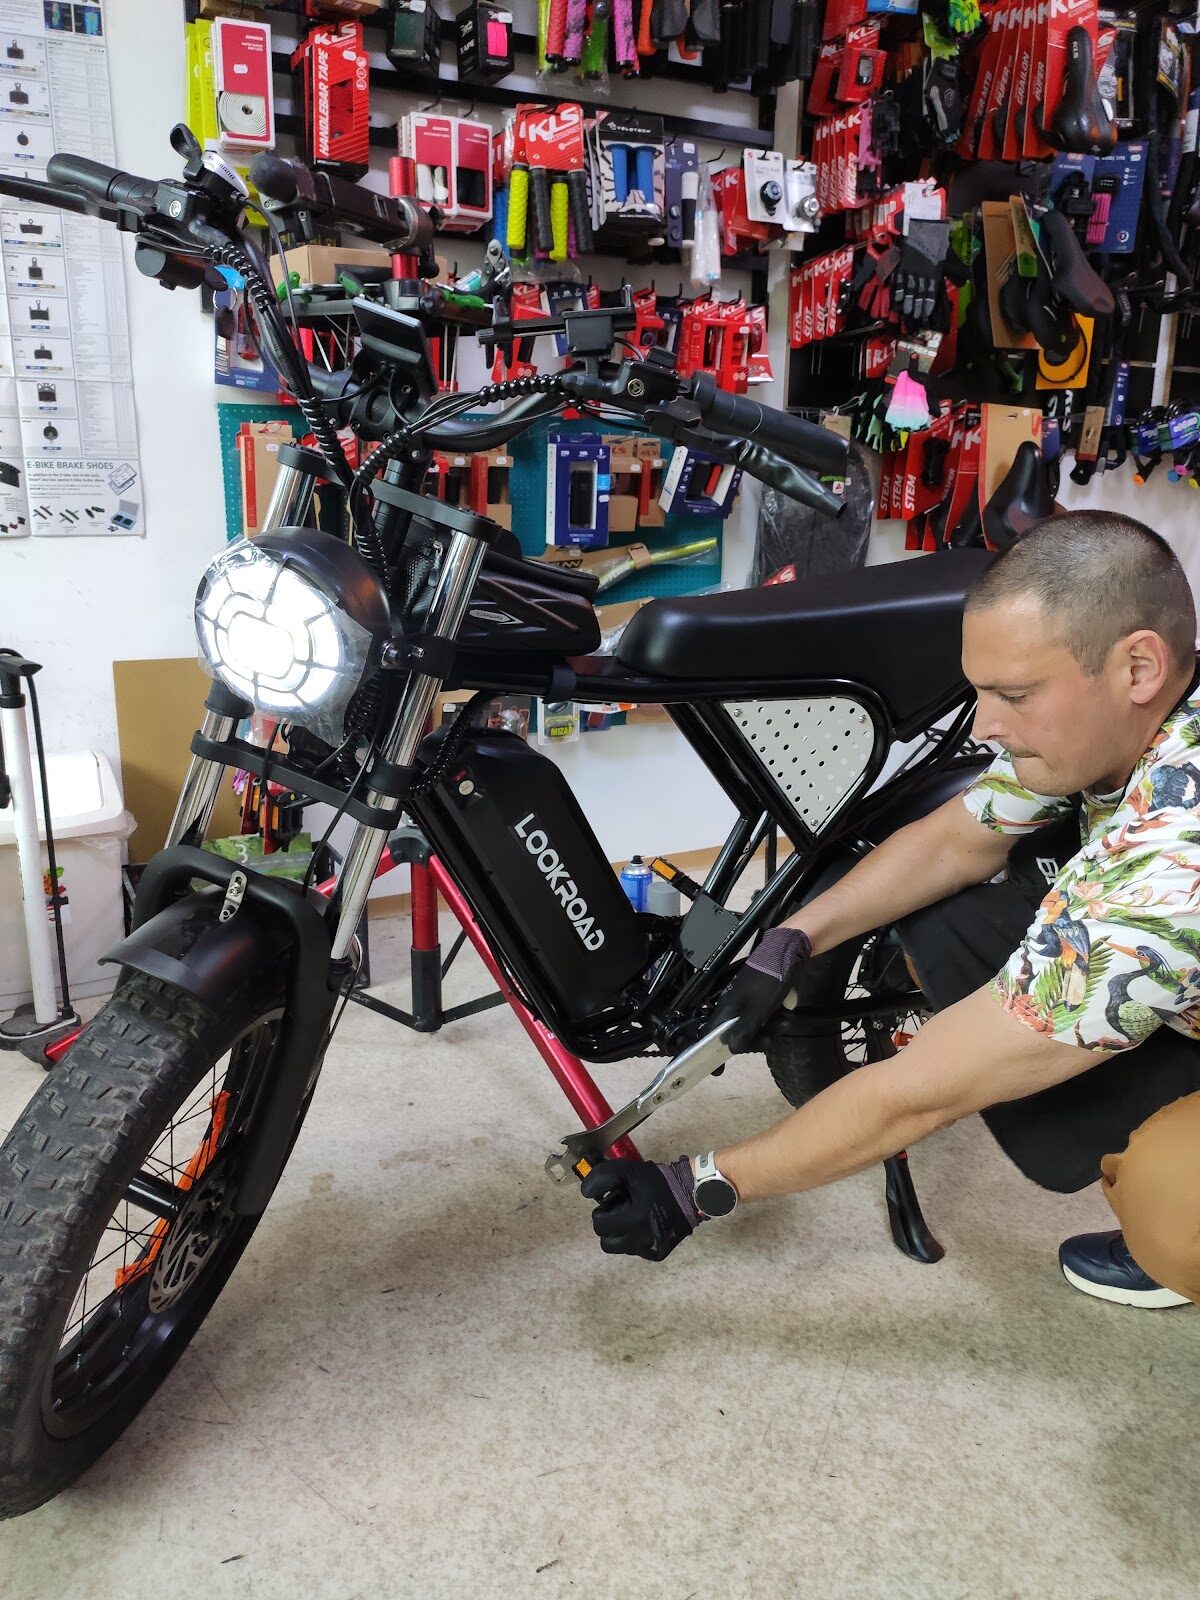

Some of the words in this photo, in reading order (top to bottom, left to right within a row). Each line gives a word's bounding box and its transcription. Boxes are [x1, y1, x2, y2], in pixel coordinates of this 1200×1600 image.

[318, 48, 329, 81] TAPE
[318, 82, 329, 156] HANDLEBAR
[529, 107, 580, 142] KLS
[804, 306, 813, 339] SLOT
[816, 302, 825, 335] SLOT
[27, 461, 54, 469] E-BIKE
[56, 461, 84, 469] BRAKE
[86, 461, 114, 470] SHOES
[880, 475, 891, 512] STEM
[892, 474, 903, 510] STEM
[904, 474, 916, 512] STEM
[514, 812, 605, 951] LOOKROAD
